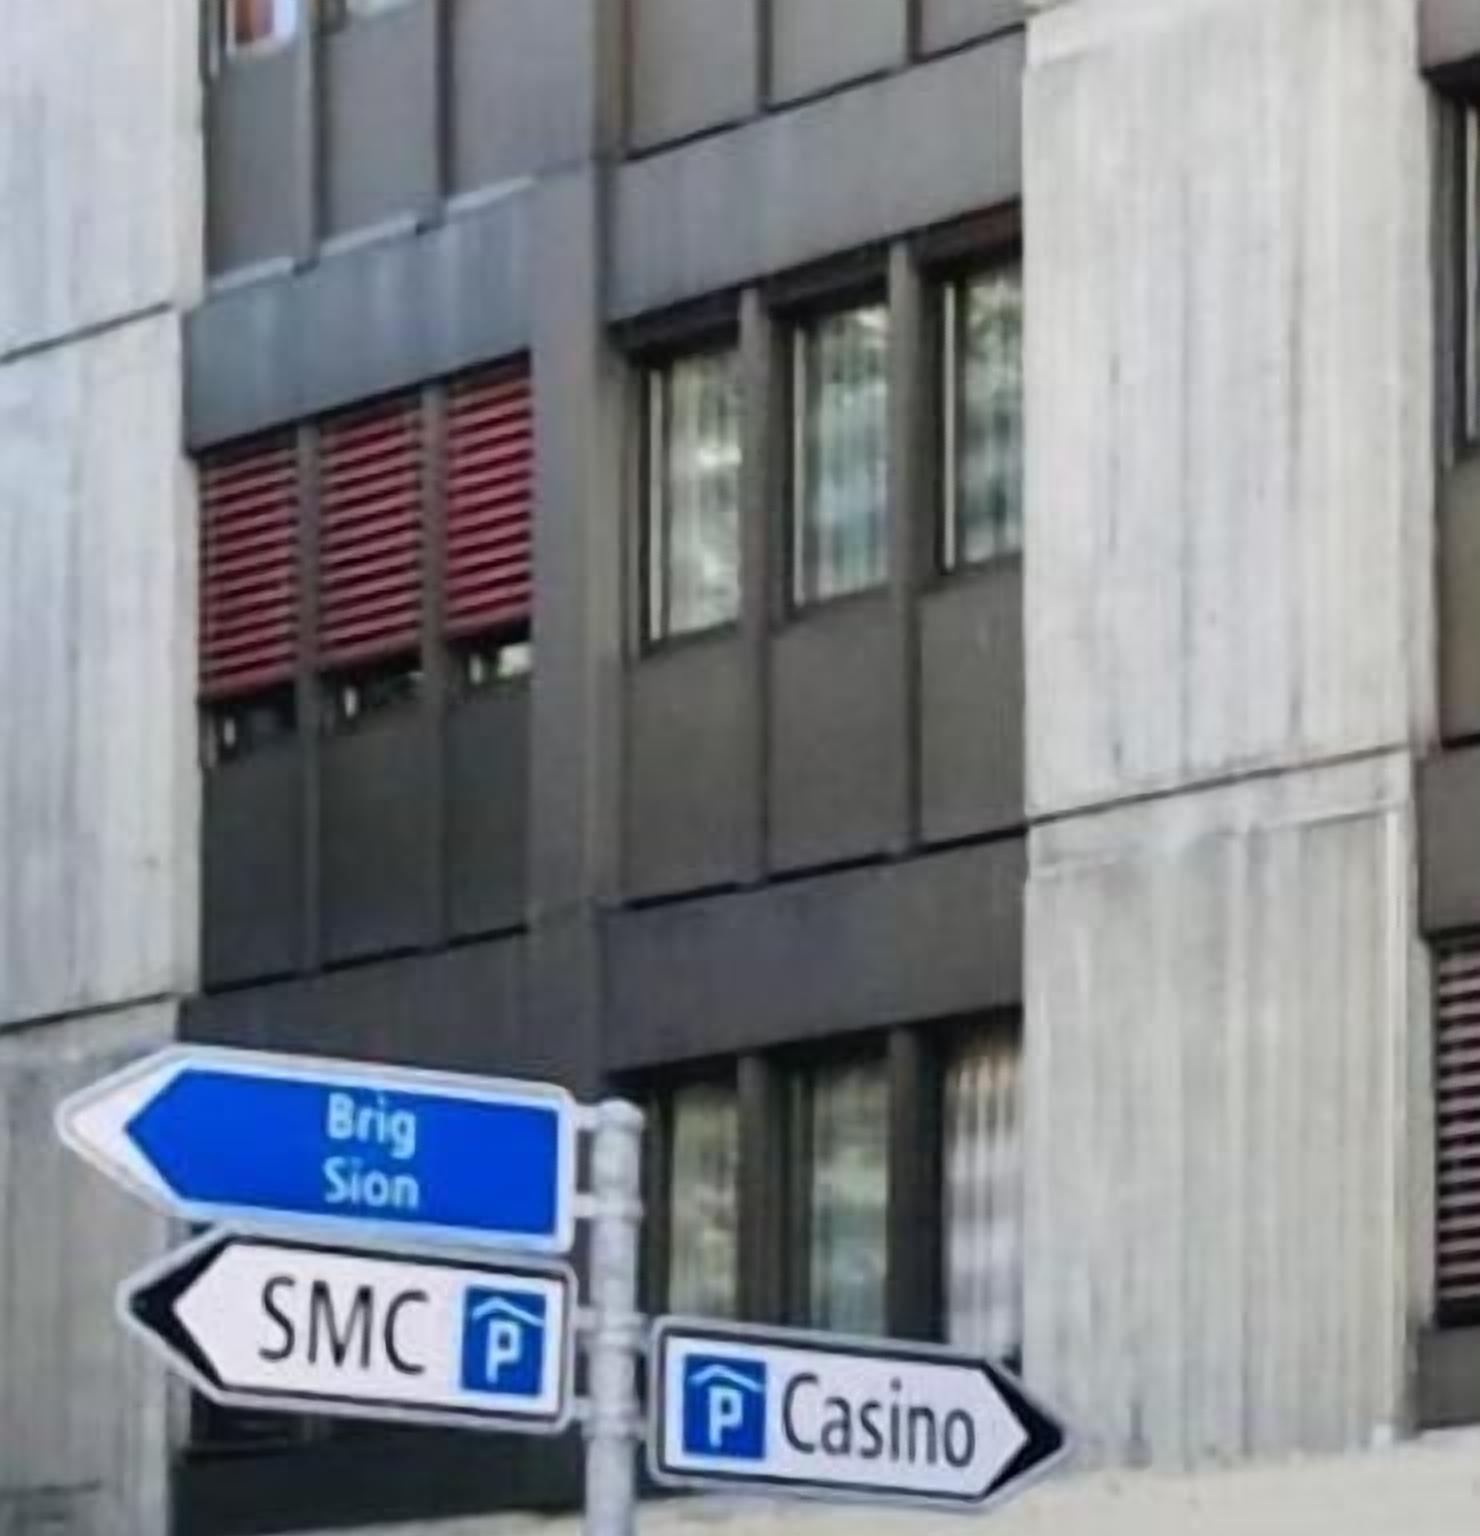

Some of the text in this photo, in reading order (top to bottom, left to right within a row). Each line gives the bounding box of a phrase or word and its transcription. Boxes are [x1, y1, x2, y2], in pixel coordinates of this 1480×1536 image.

[327, 1090, 417, 1160] Brig
[323, 1156, 420, 1209] Sion
[258, 1274, 523, 1384] SMC P
[708, 1371, 976, 1468] P Casino
